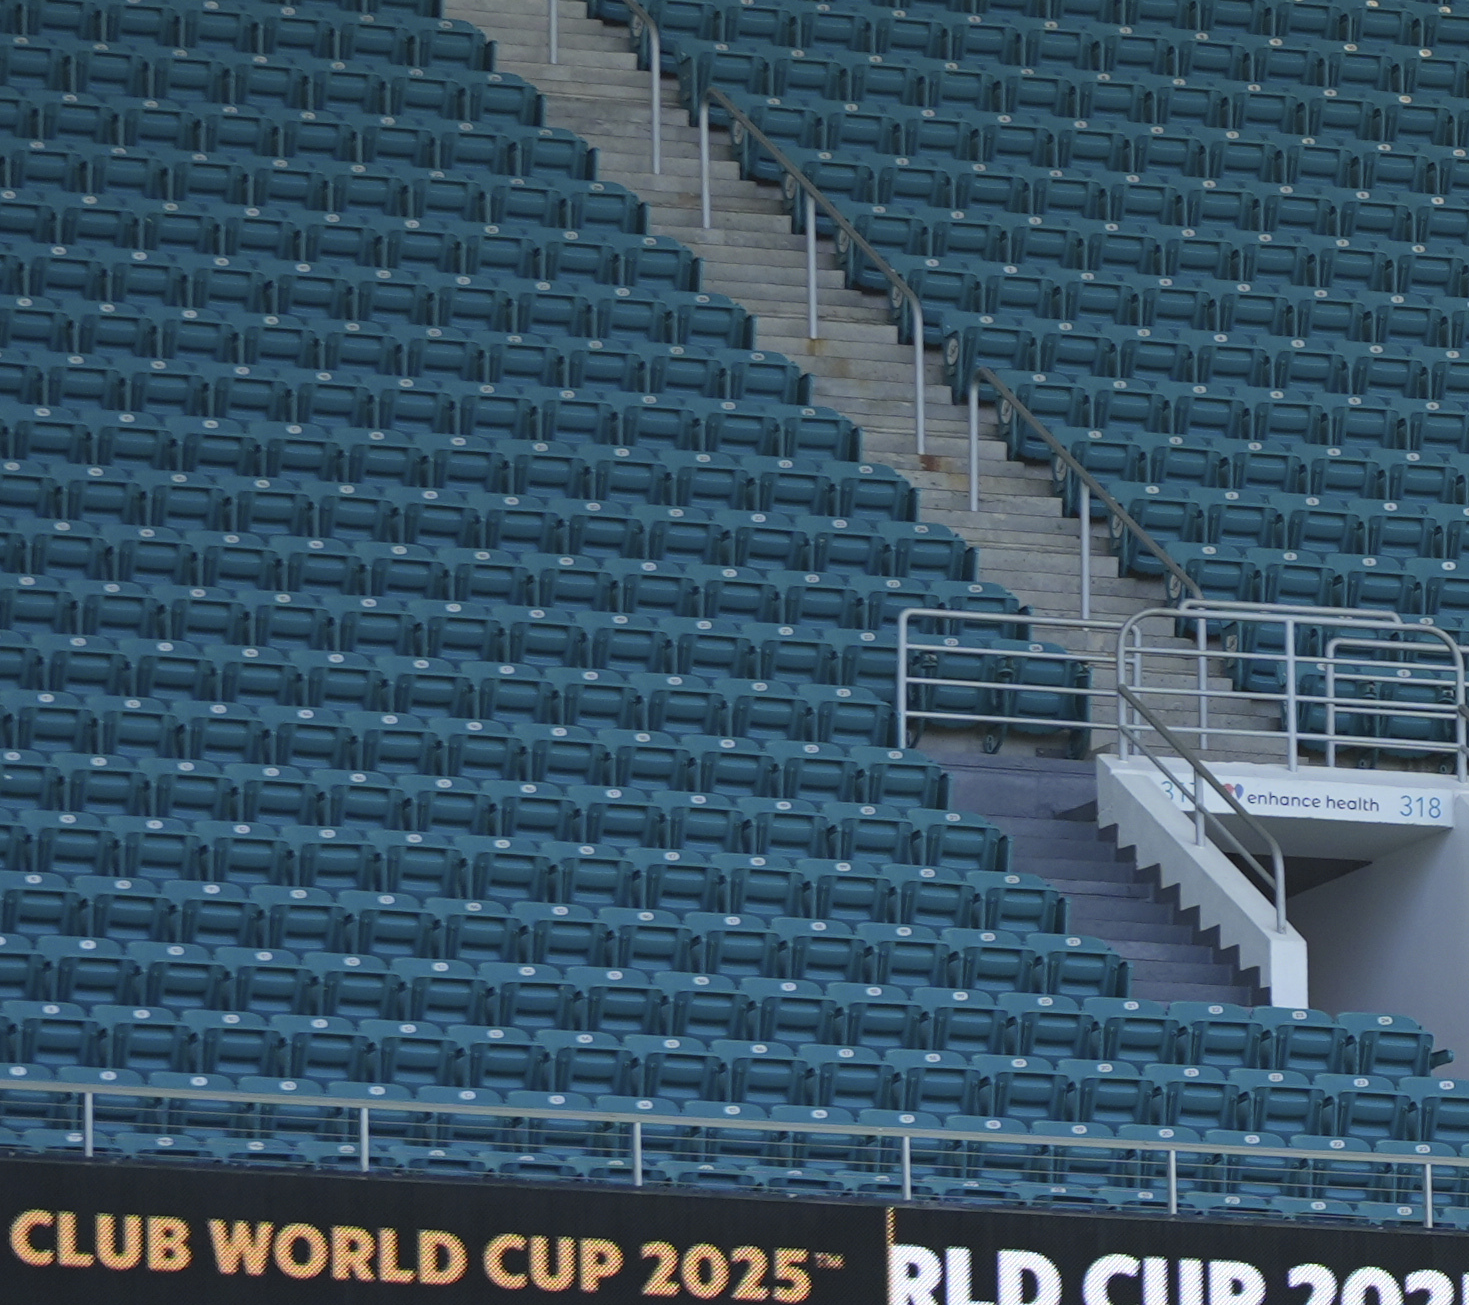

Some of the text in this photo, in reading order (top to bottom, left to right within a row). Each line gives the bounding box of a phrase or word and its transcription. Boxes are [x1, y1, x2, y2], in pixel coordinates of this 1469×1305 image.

[1160, 780, 1196, 803] 31
[1247, 792, 1380, 812] enhance health
[1400, 795, 1442, 819] 318
[10, 1210, 191, 1271] CLUB
[210, 1220, 467, 1284] WORLD
[485, 1234, 623, 1292] CUP
